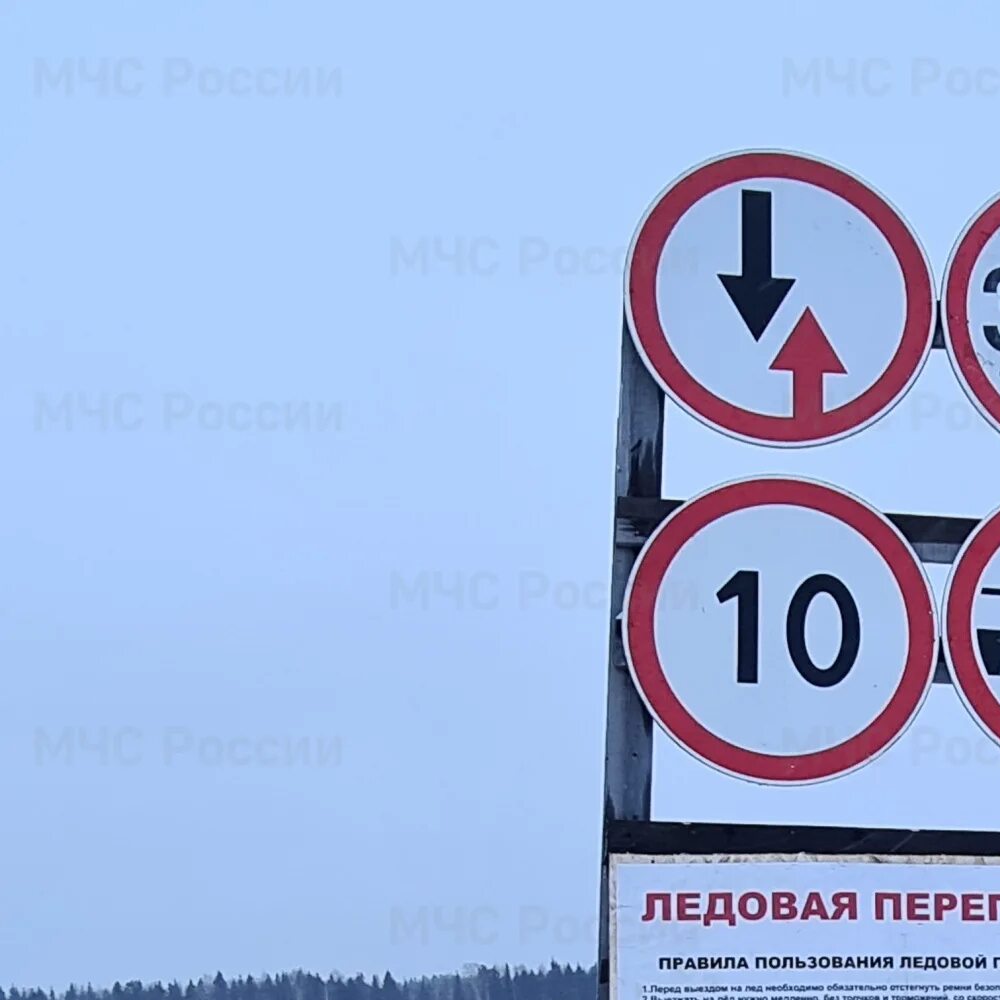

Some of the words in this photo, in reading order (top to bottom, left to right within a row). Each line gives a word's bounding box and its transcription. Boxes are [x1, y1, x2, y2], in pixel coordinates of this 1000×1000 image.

[716, 570, 861, 688] 10
[641, 892, 858, 926] ЛЕДОВАЯ
[658, 957, 749, 970] ПРАВИЛА
[755, 956, 894, 969] ПОЛЬЗОВАНИЯ
[899, 954, 987, 971] ЛЕДОВОЙ
[642, 984, 682, 994] 1.Перед
[683, 985, 728, 994] выездом
[744, 985, 764, 993] лед
[764, 983, 825, 993] необходимо
[826, 983, 888, 991] обязательно
[889, 985, 941, 993] отстегнуть
[942, 984, 972, 993] ремни
